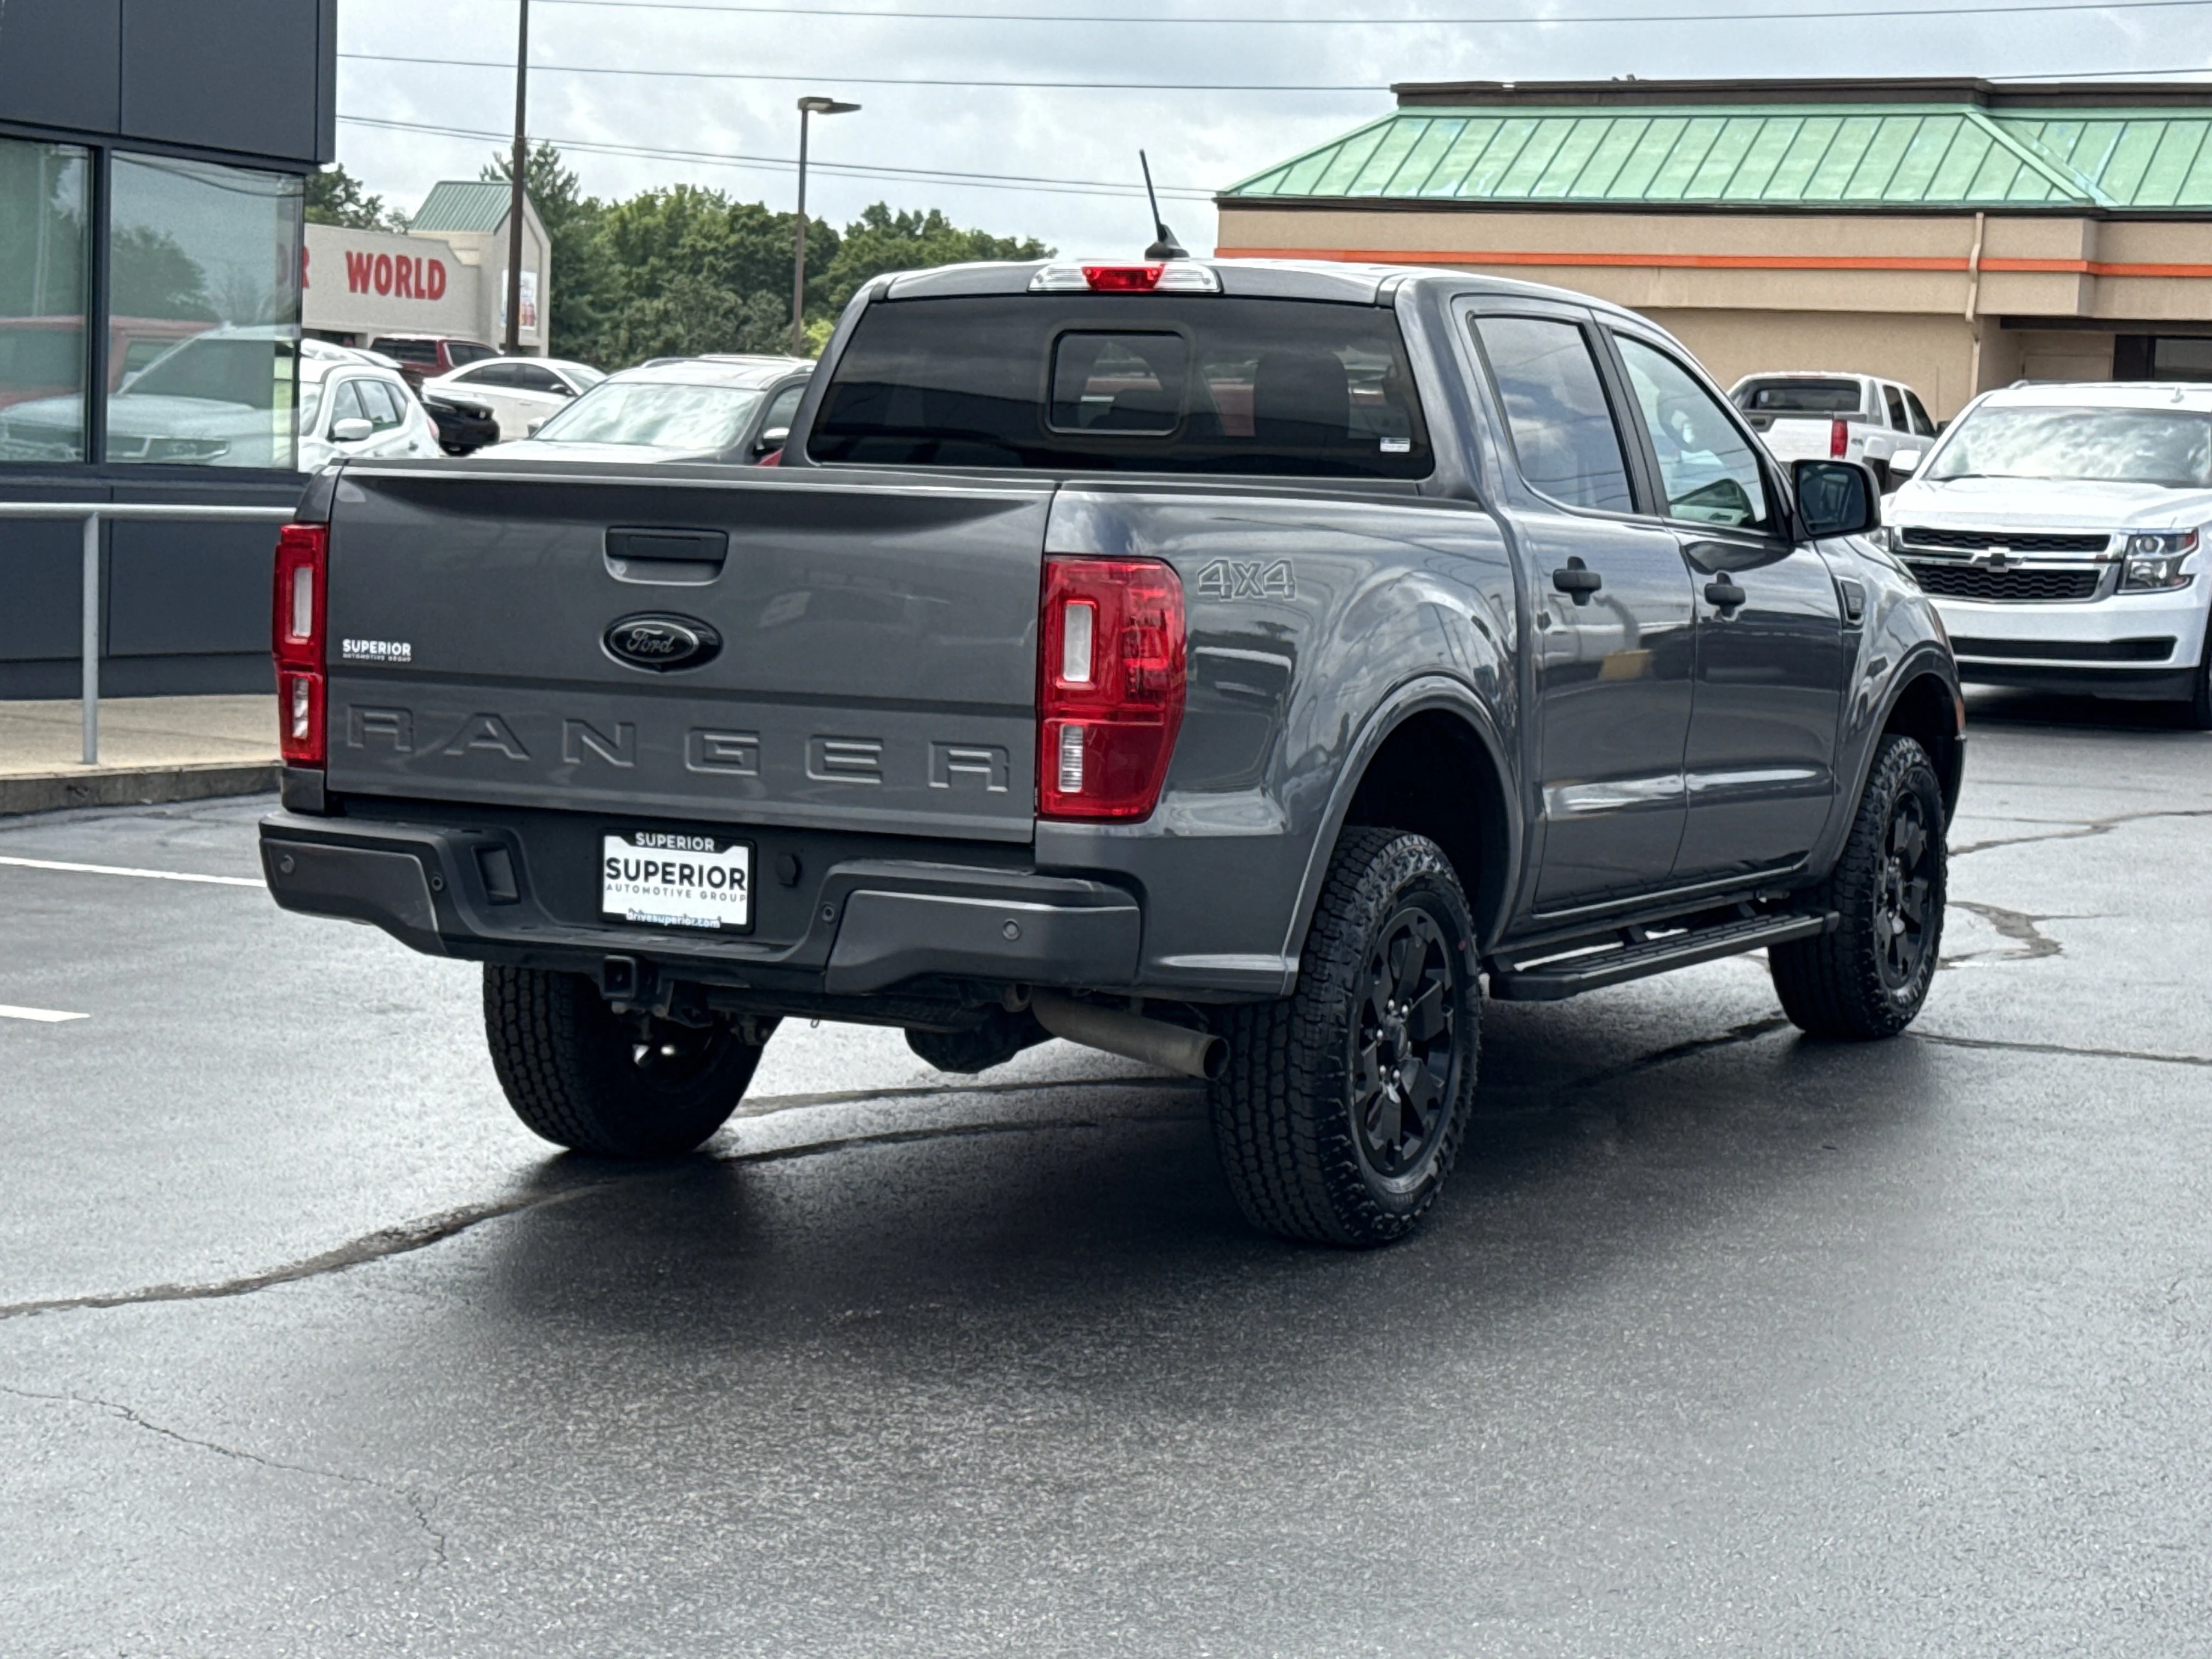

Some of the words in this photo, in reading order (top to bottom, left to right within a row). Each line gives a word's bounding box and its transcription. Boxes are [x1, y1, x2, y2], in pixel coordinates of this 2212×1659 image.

[345, 250, 446, 300] WORLD
[342, 639, 411, 656] SUPERIOR
[626, 627, 675, 653] Ford
[347, 704, 1009, 793] RANGER
[635, 832, 715, 852] SUPERIOR
[606, 857, 746, 891] SUPERIOR
[606, 883, 692, 899] AUTOMOTIVE
[699, 890, 746, 902] GROUP
[626, 907, 721, 929] drivesuperior.com
